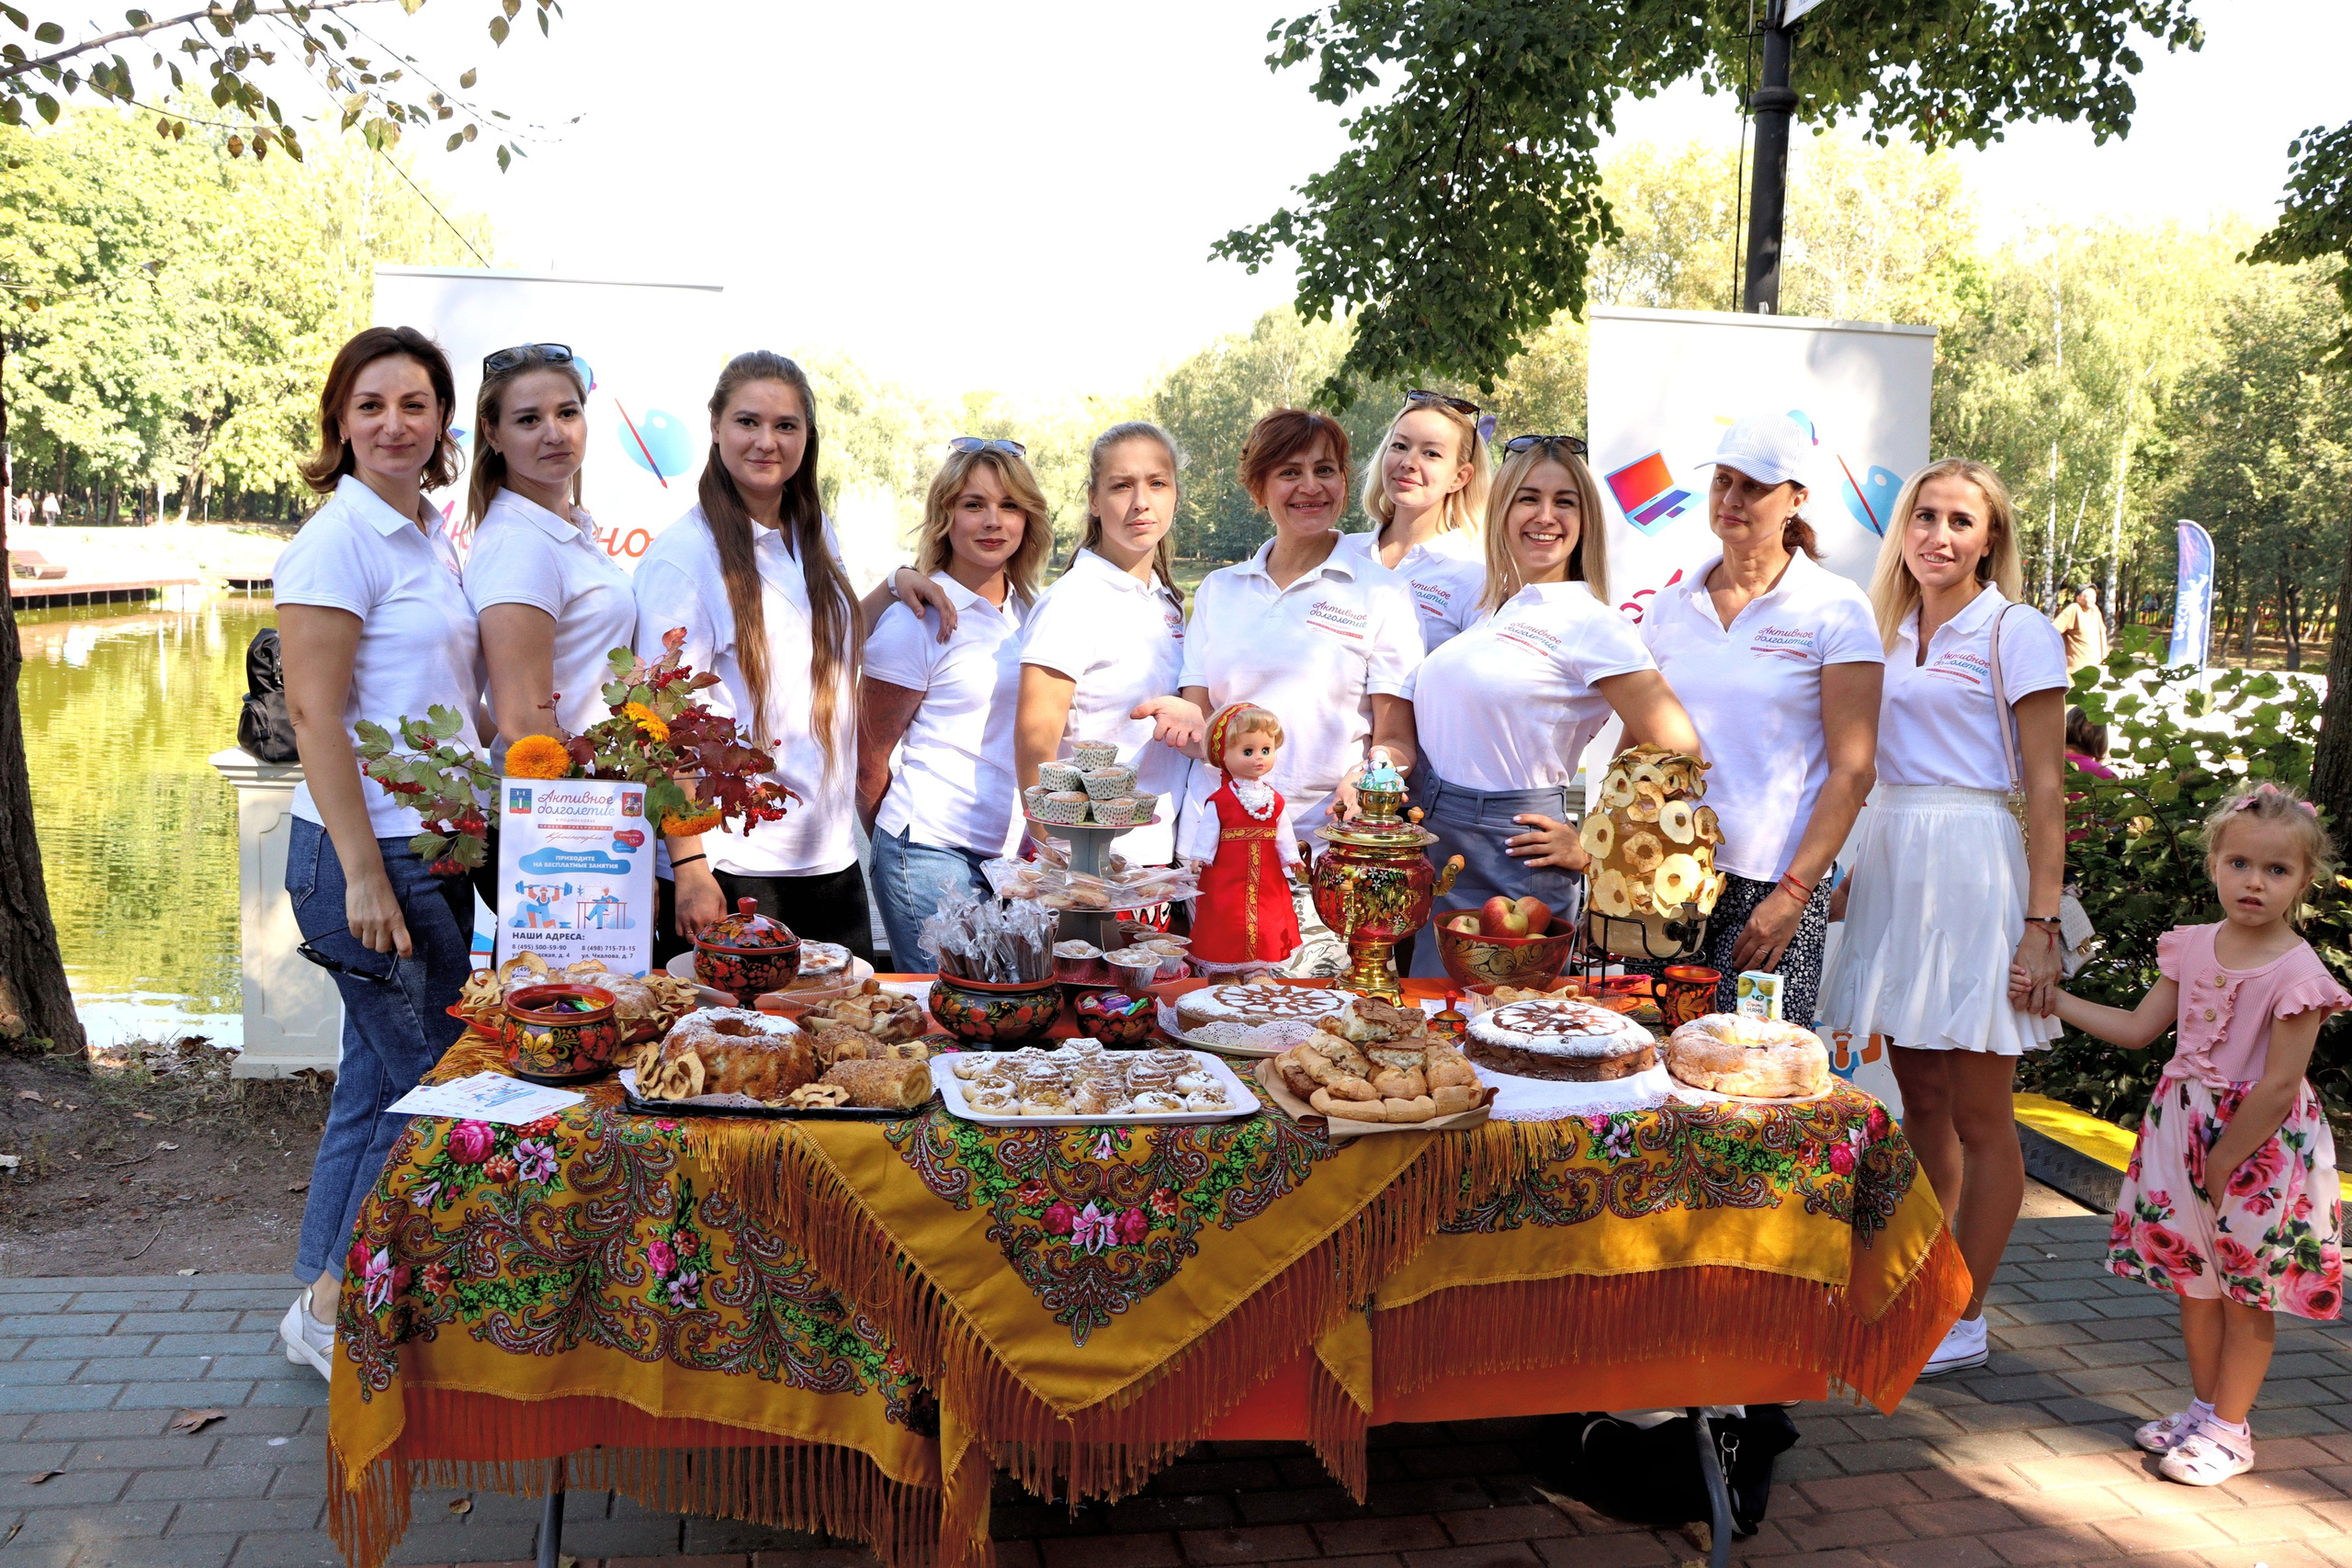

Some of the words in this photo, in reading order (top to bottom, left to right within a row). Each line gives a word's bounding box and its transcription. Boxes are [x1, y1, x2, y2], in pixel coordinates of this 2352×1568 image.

[1309, 607, 1368, 628] долголетие
[1312, 601, 1368, 620] Активное
[1758, 626, 1814, 638] Активное
[1754, 633, 1814, 648] долголетие
[537, 789, 614, 805] Активное
[537, 801, 616, 817] долголетие
[546, 933, 585, 942] АДРЕСА:
